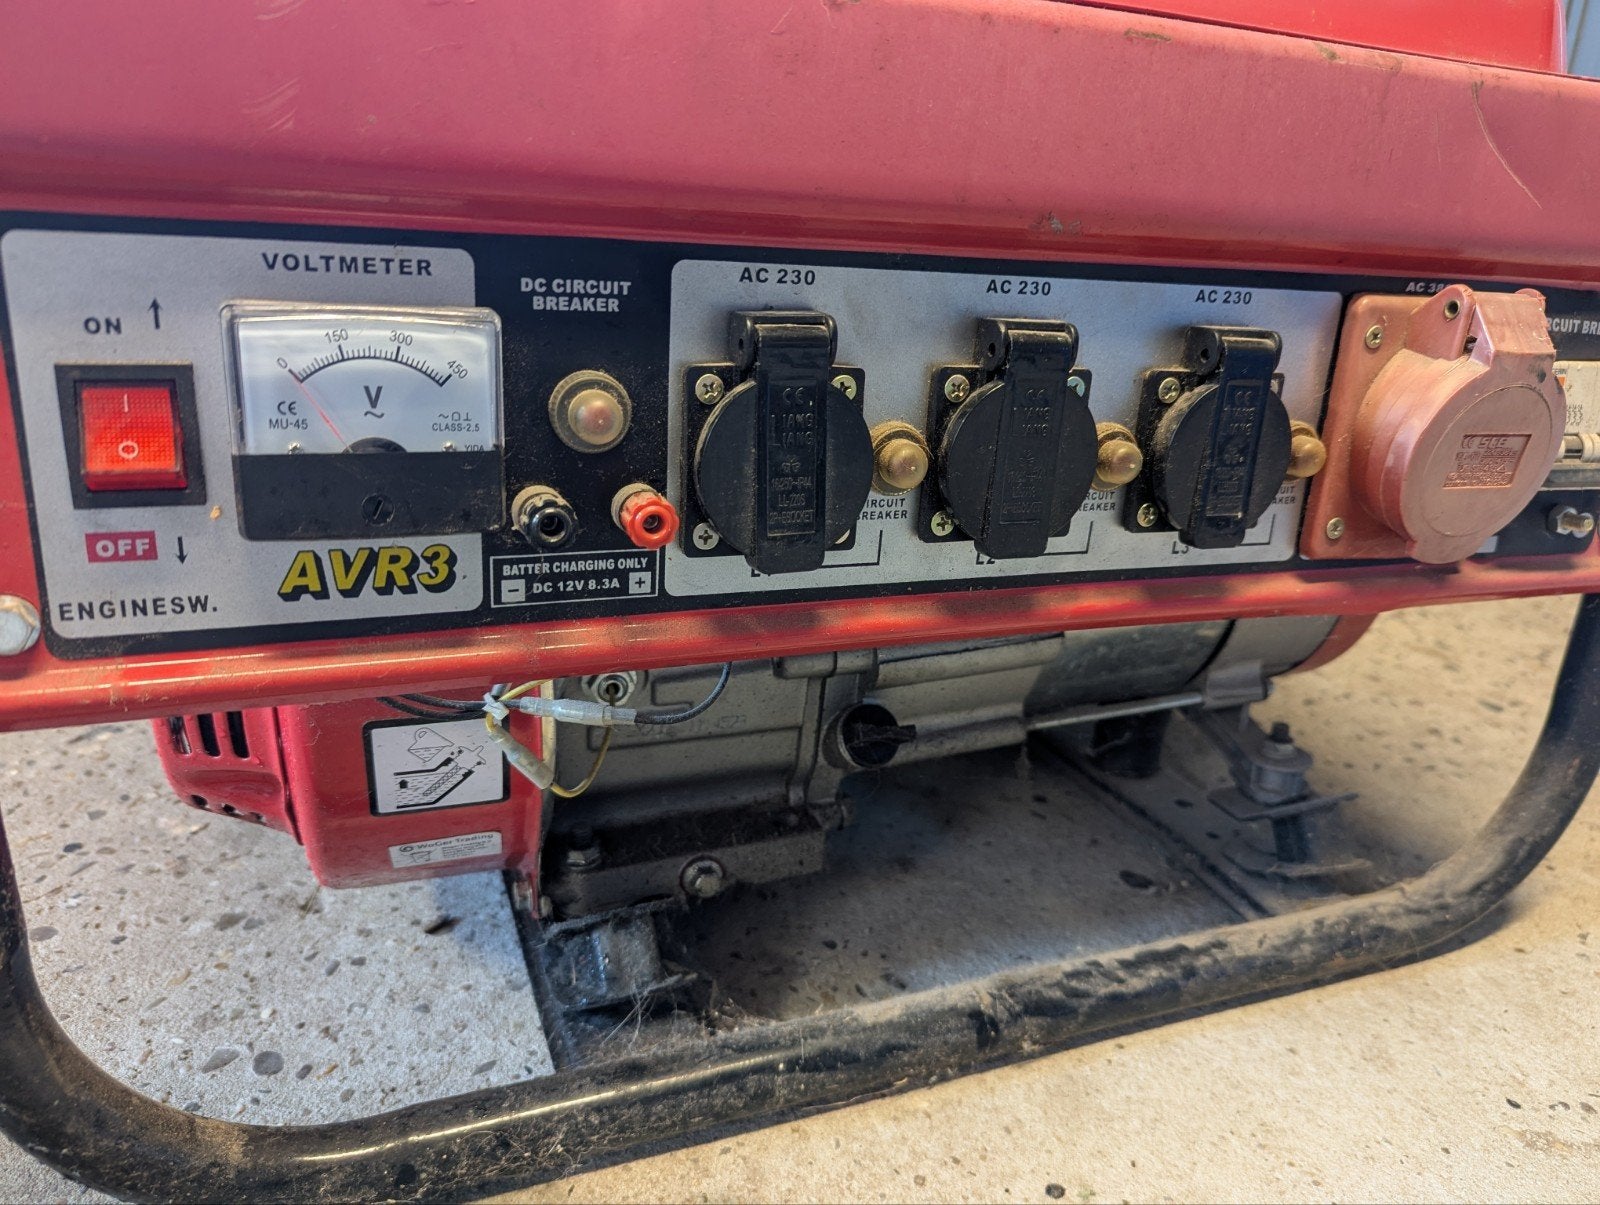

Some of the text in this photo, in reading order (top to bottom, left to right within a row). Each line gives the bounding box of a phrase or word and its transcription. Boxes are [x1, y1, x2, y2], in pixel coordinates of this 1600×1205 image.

[262, 252, 433, 277] VOLTMETER
[739, 267, 816, 286] AC 230
[520, 277, 632, 295] DC CIRCUIT
[986, 279, 1052, 296] AC 230
[1405, 282, 1450, 293] AC 38
[532, 295, 620, 313] BREAKER
[1195, 289, 1253, 306] AC 230
[83, 316, 122, 335] ON
[324, 328, 349, 345] 150
[389, 330, 413, 347] 300
[276, 357, 288, 370] 0
[446, 359, 468, 380] 450
[363, 385, 383, 409] V
[269, 418, 308, 431] MU-45
[431, 423, 480, 432] CLASS-2.5
[866, 498, 906, 508] IRCUIT
[1086, 491, 1116, 501] RCUIT
[1080, 502, 1116, 512] EAKER
[95, 539, 150, 559] OFF
[278, 544, 458, 602] AVR3
[502, 557, 649, 576] BATTER CHARGING ONLY
[532, 578, 620, 594] DC 12V 8.3A
[58, 594, 219, 622] ENGINESW.
[455, 833, 494, 844] Trading
